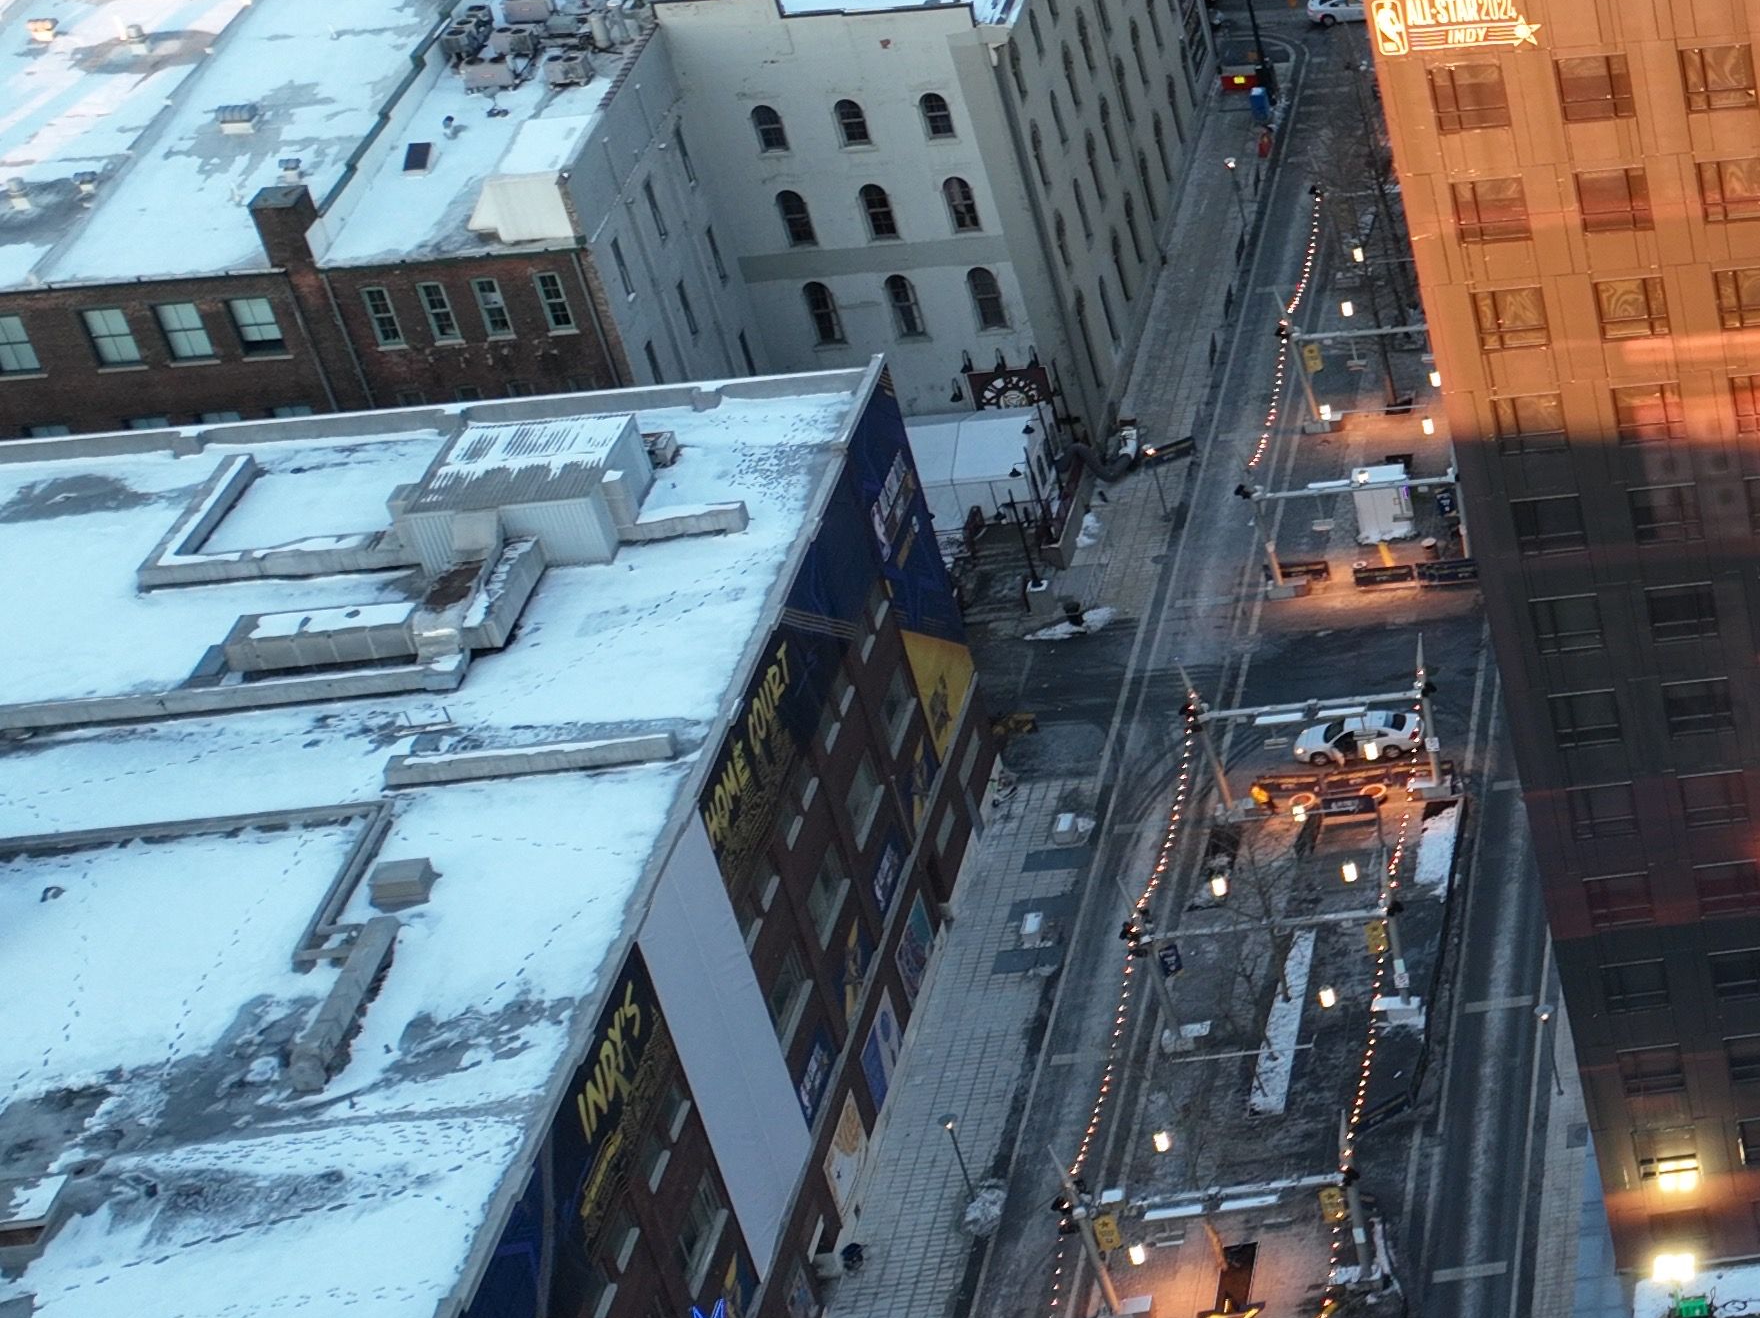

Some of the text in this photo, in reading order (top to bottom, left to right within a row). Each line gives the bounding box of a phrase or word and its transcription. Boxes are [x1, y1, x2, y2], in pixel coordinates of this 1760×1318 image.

[1447, 27, 1488, 44] INDY
[704, 642, 790, 848] HOME COURT
